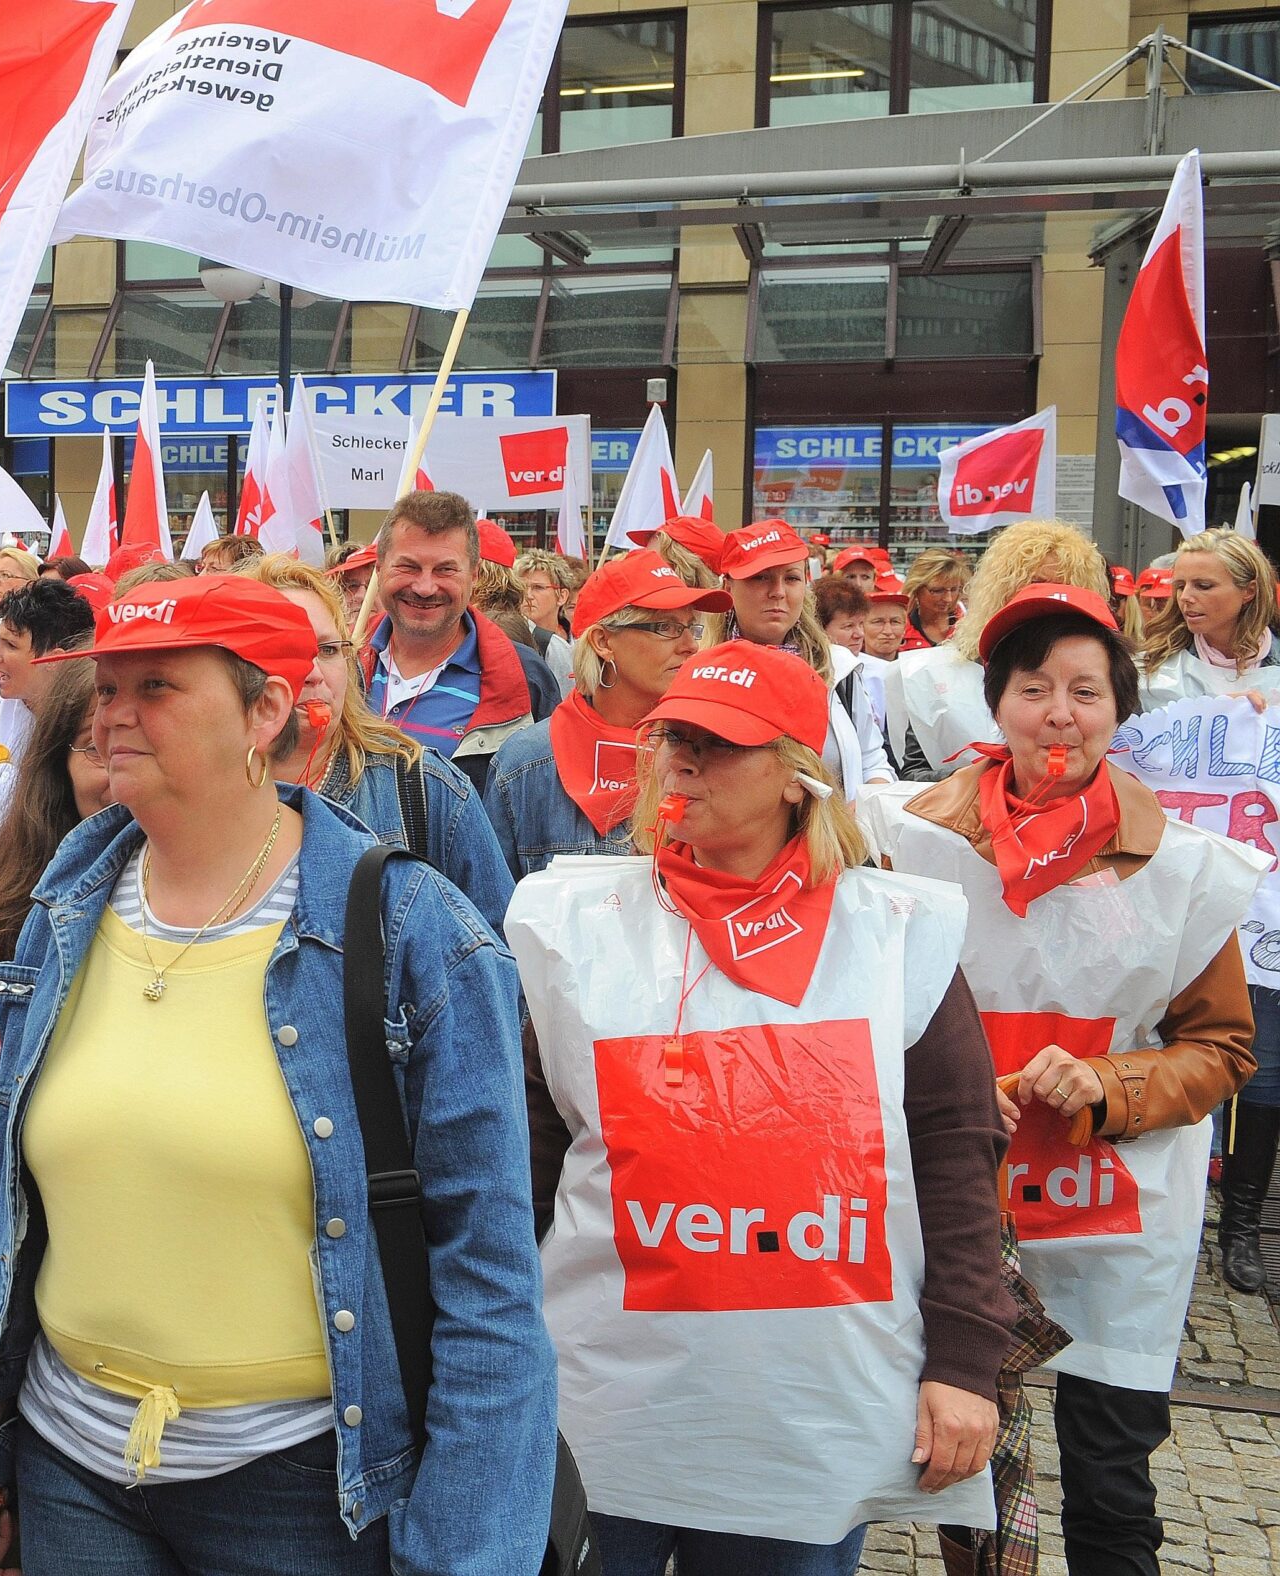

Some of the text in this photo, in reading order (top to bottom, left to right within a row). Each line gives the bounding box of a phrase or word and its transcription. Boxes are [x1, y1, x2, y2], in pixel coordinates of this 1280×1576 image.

[332, 435, 408, 450] Schlecker
[351, 468, 384, 481] Marl
[741, 531, 781, 551] ver.di
[692, 665, 758, 689] ver.di
[625, 1194, 867, 1264] ver.di
